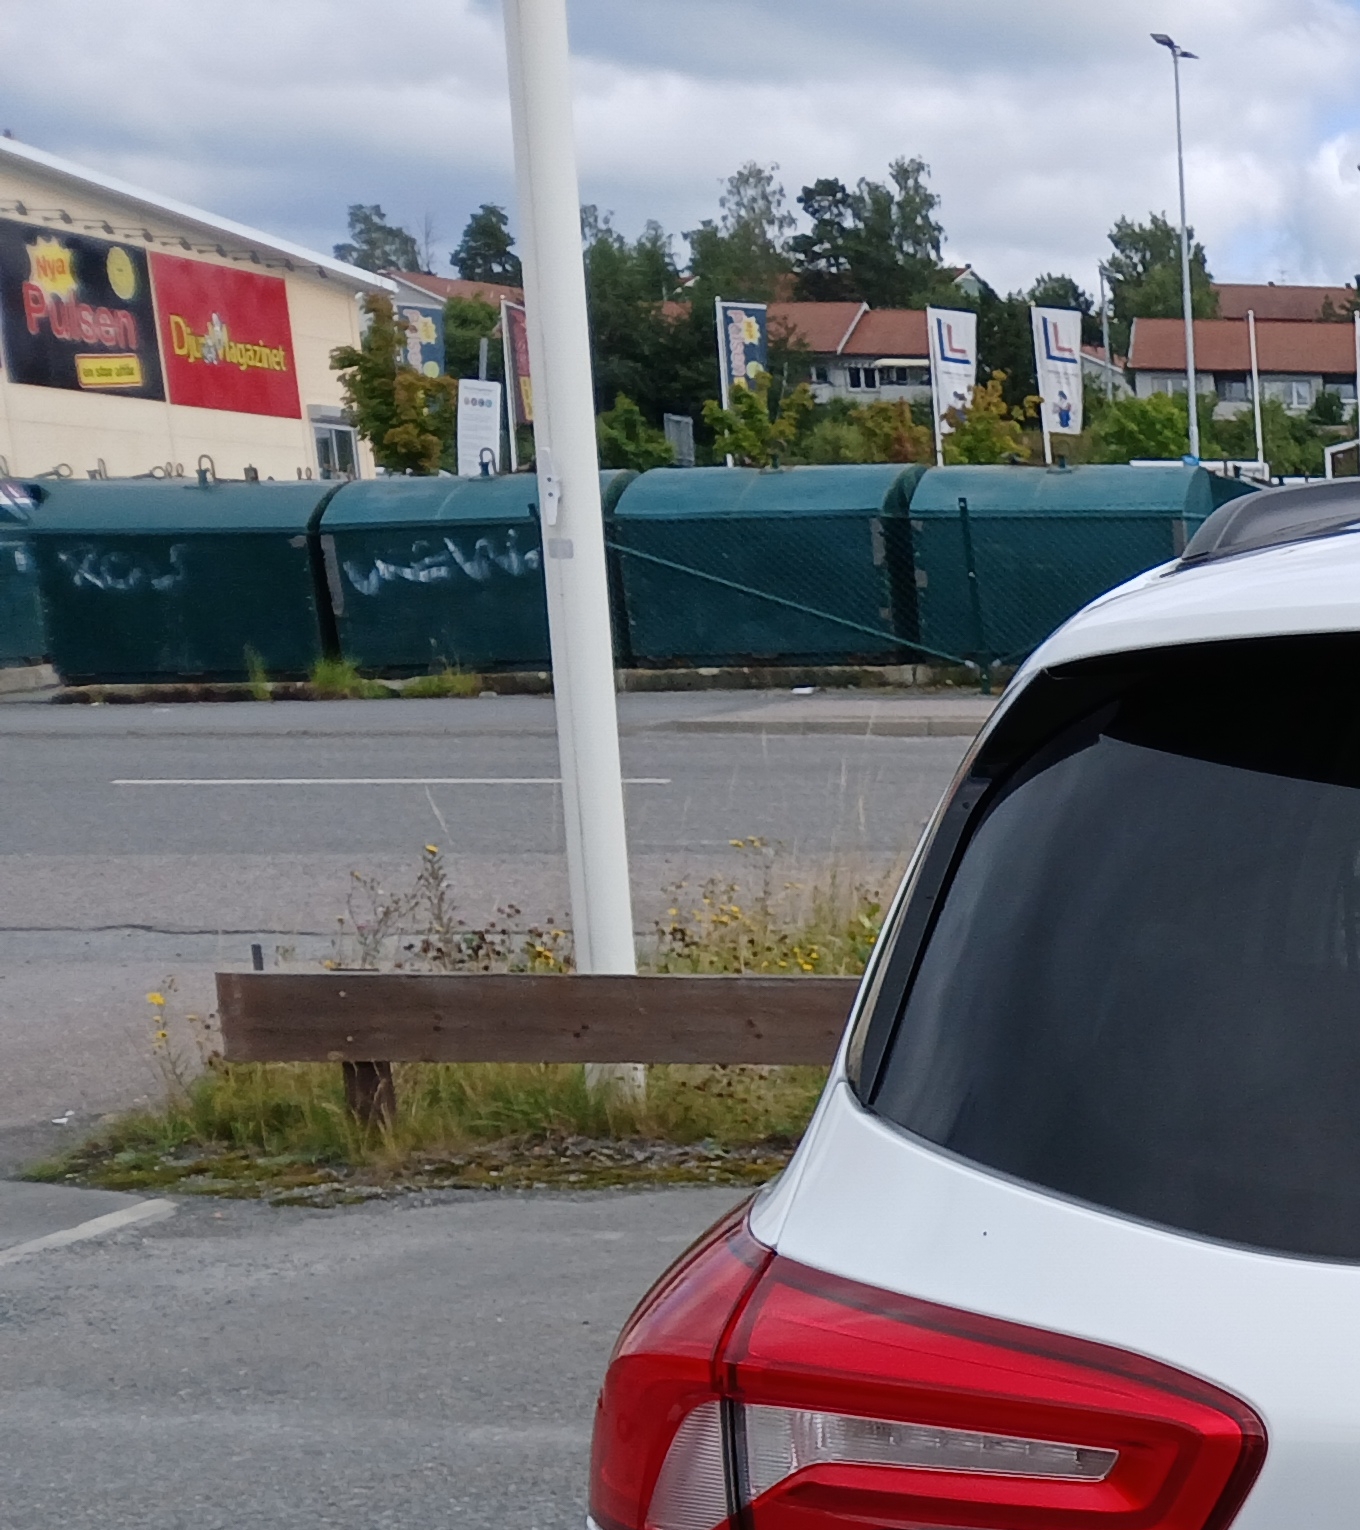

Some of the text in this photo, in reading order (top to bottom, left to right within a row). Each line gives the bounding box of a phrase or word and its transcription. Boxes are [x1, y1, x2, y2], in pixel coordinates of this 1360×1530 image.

[35, 255, 67, 283] Nya
[22, 281, 138, 350] Pulsen
[169, 314, 287, 371] DjuMagazinet
